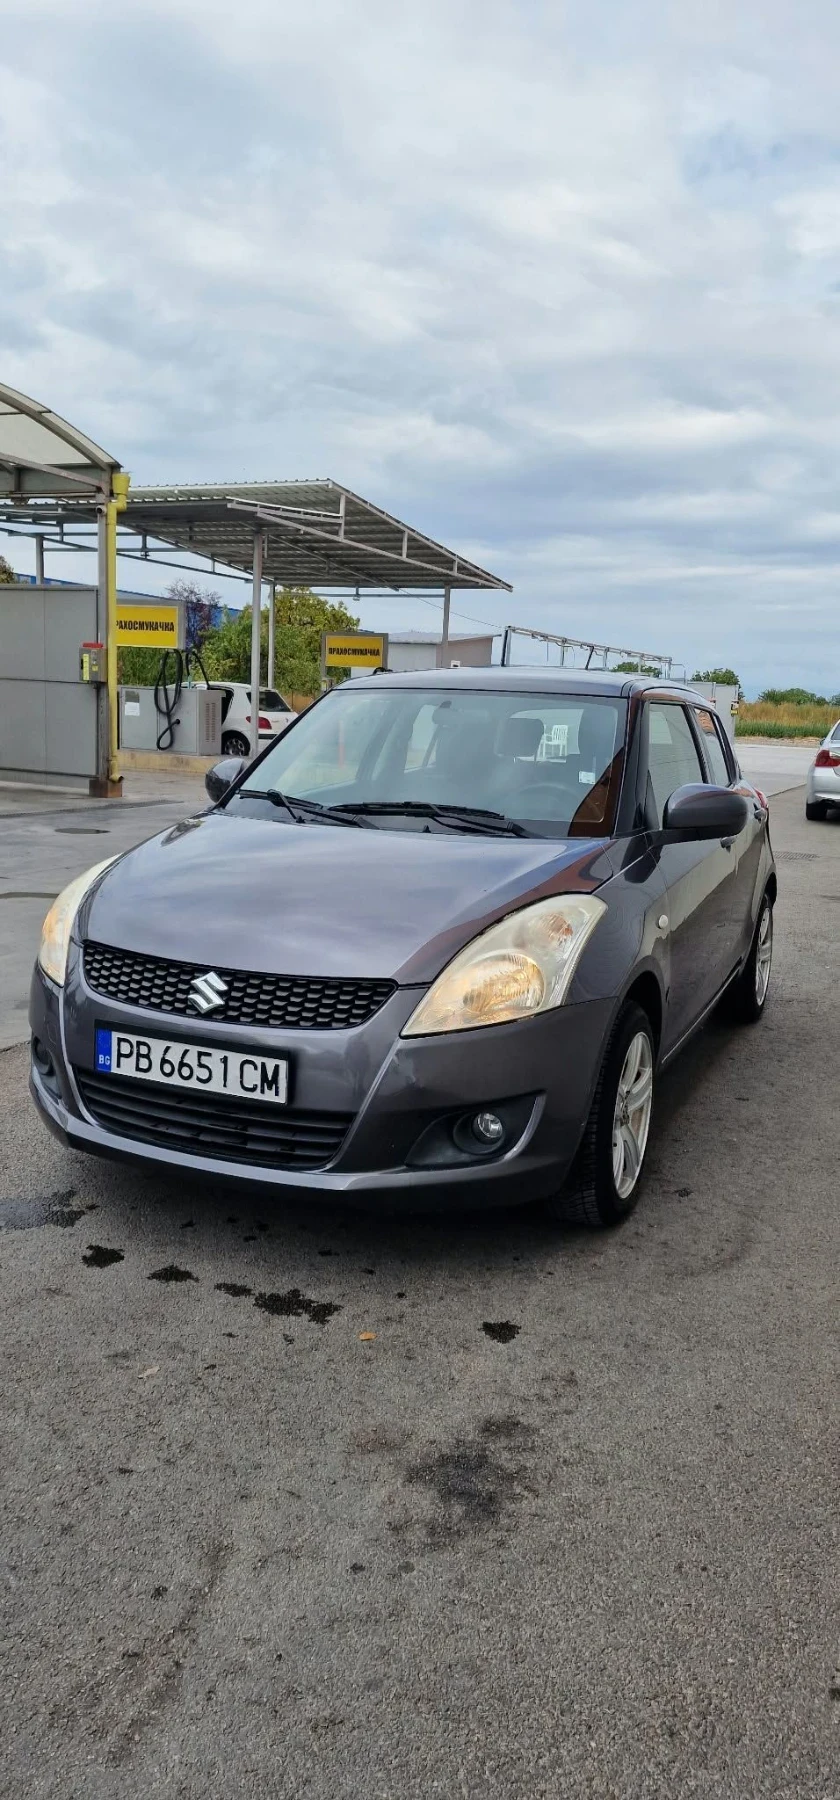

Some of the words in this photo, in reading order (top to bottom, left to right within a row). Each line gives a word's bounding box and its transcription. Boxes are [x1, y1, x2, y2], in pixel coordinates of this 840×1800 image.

[328, 647, 380, 656] ПРАХОСМУКАЧКА
[98, 1054, 111, 1065] BG
[116, 1037, 152, 1073] PB
[159, 1045, 228, 1088] 6651
[239, 1059, 280, 1096] CM
